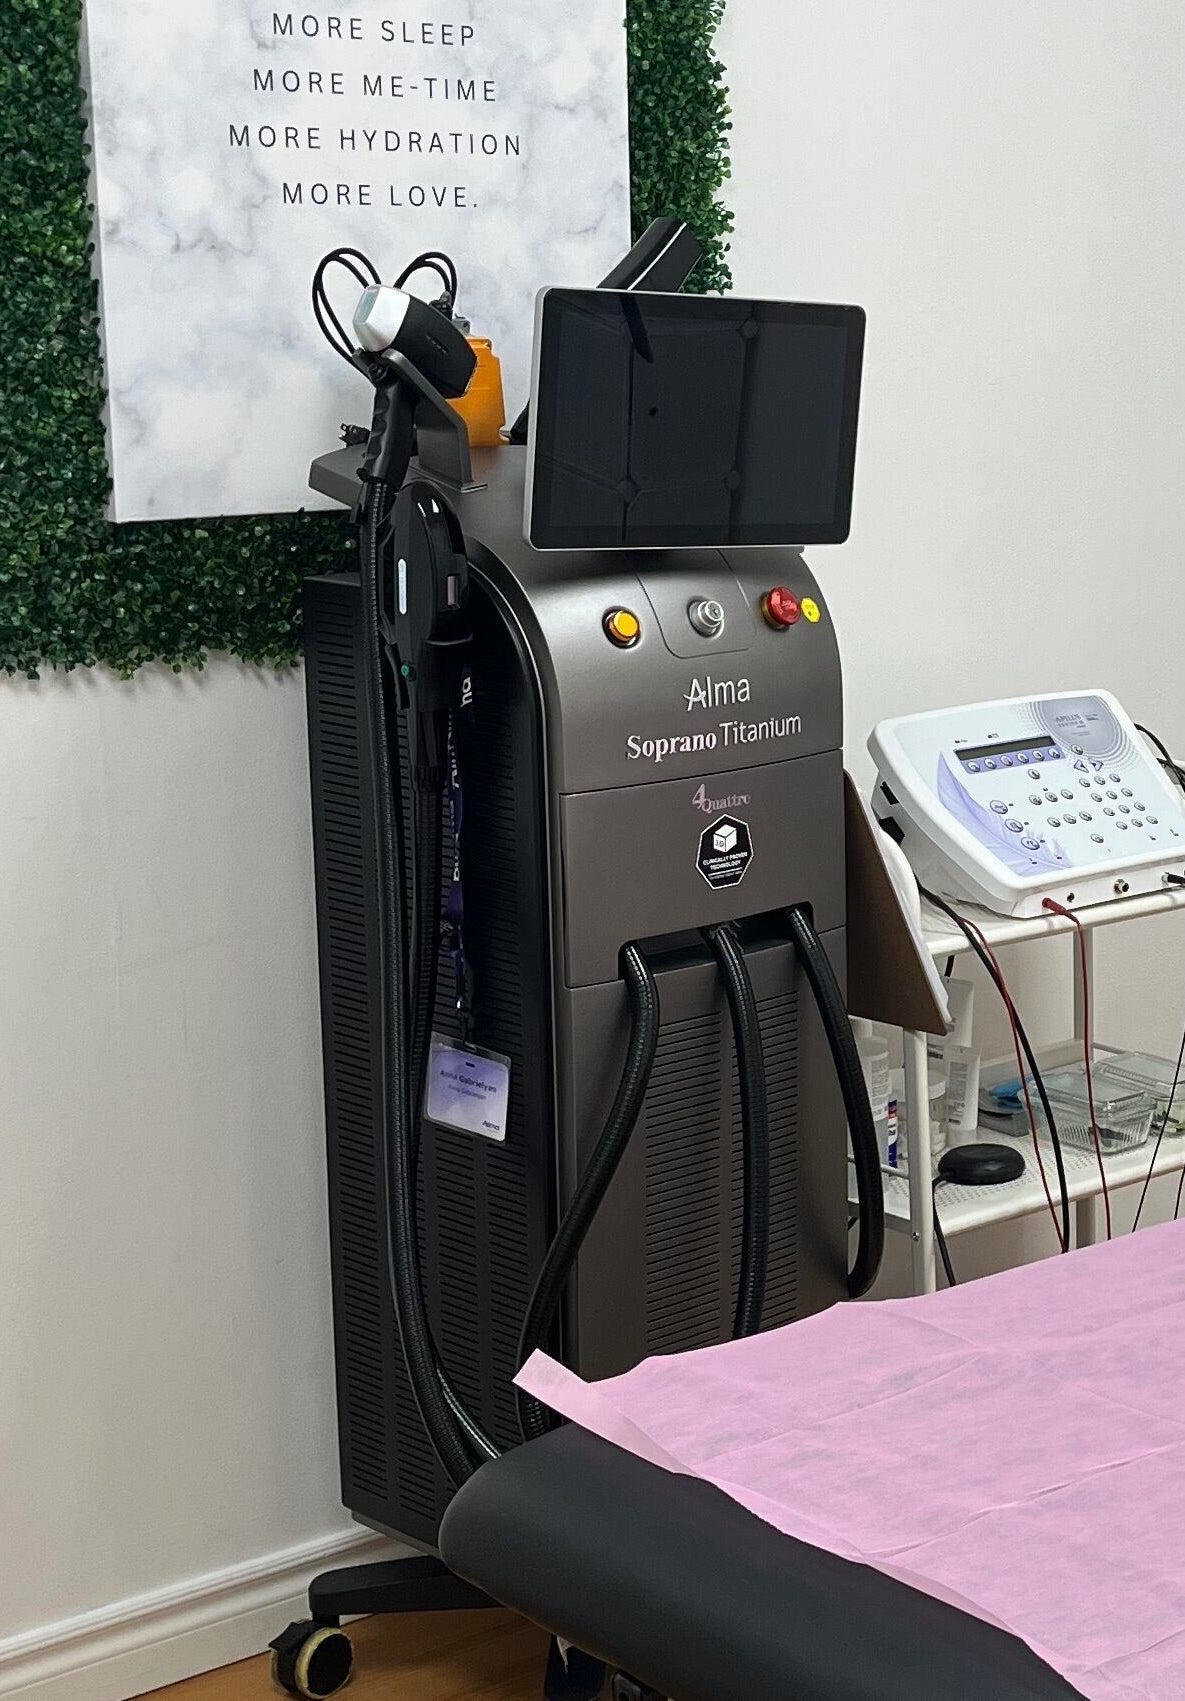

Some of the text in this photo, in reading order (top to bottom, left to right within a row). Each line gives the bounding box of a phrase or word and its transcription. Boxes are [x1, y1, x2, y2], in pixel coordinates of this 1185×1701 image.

[272, 12, 474, 46] MORE SLEEP
[253, 68, 496, 101] MORE ME-TIME
[229, 124, 520, 156] MORE HYDRATION
[282, 182, 478, 208] MORE LOVE.
[683, 676, 750, 712] Alma
[626, 715, 801, 763] Soprano Titanium
[701, 793, 750, 814] Quattro
